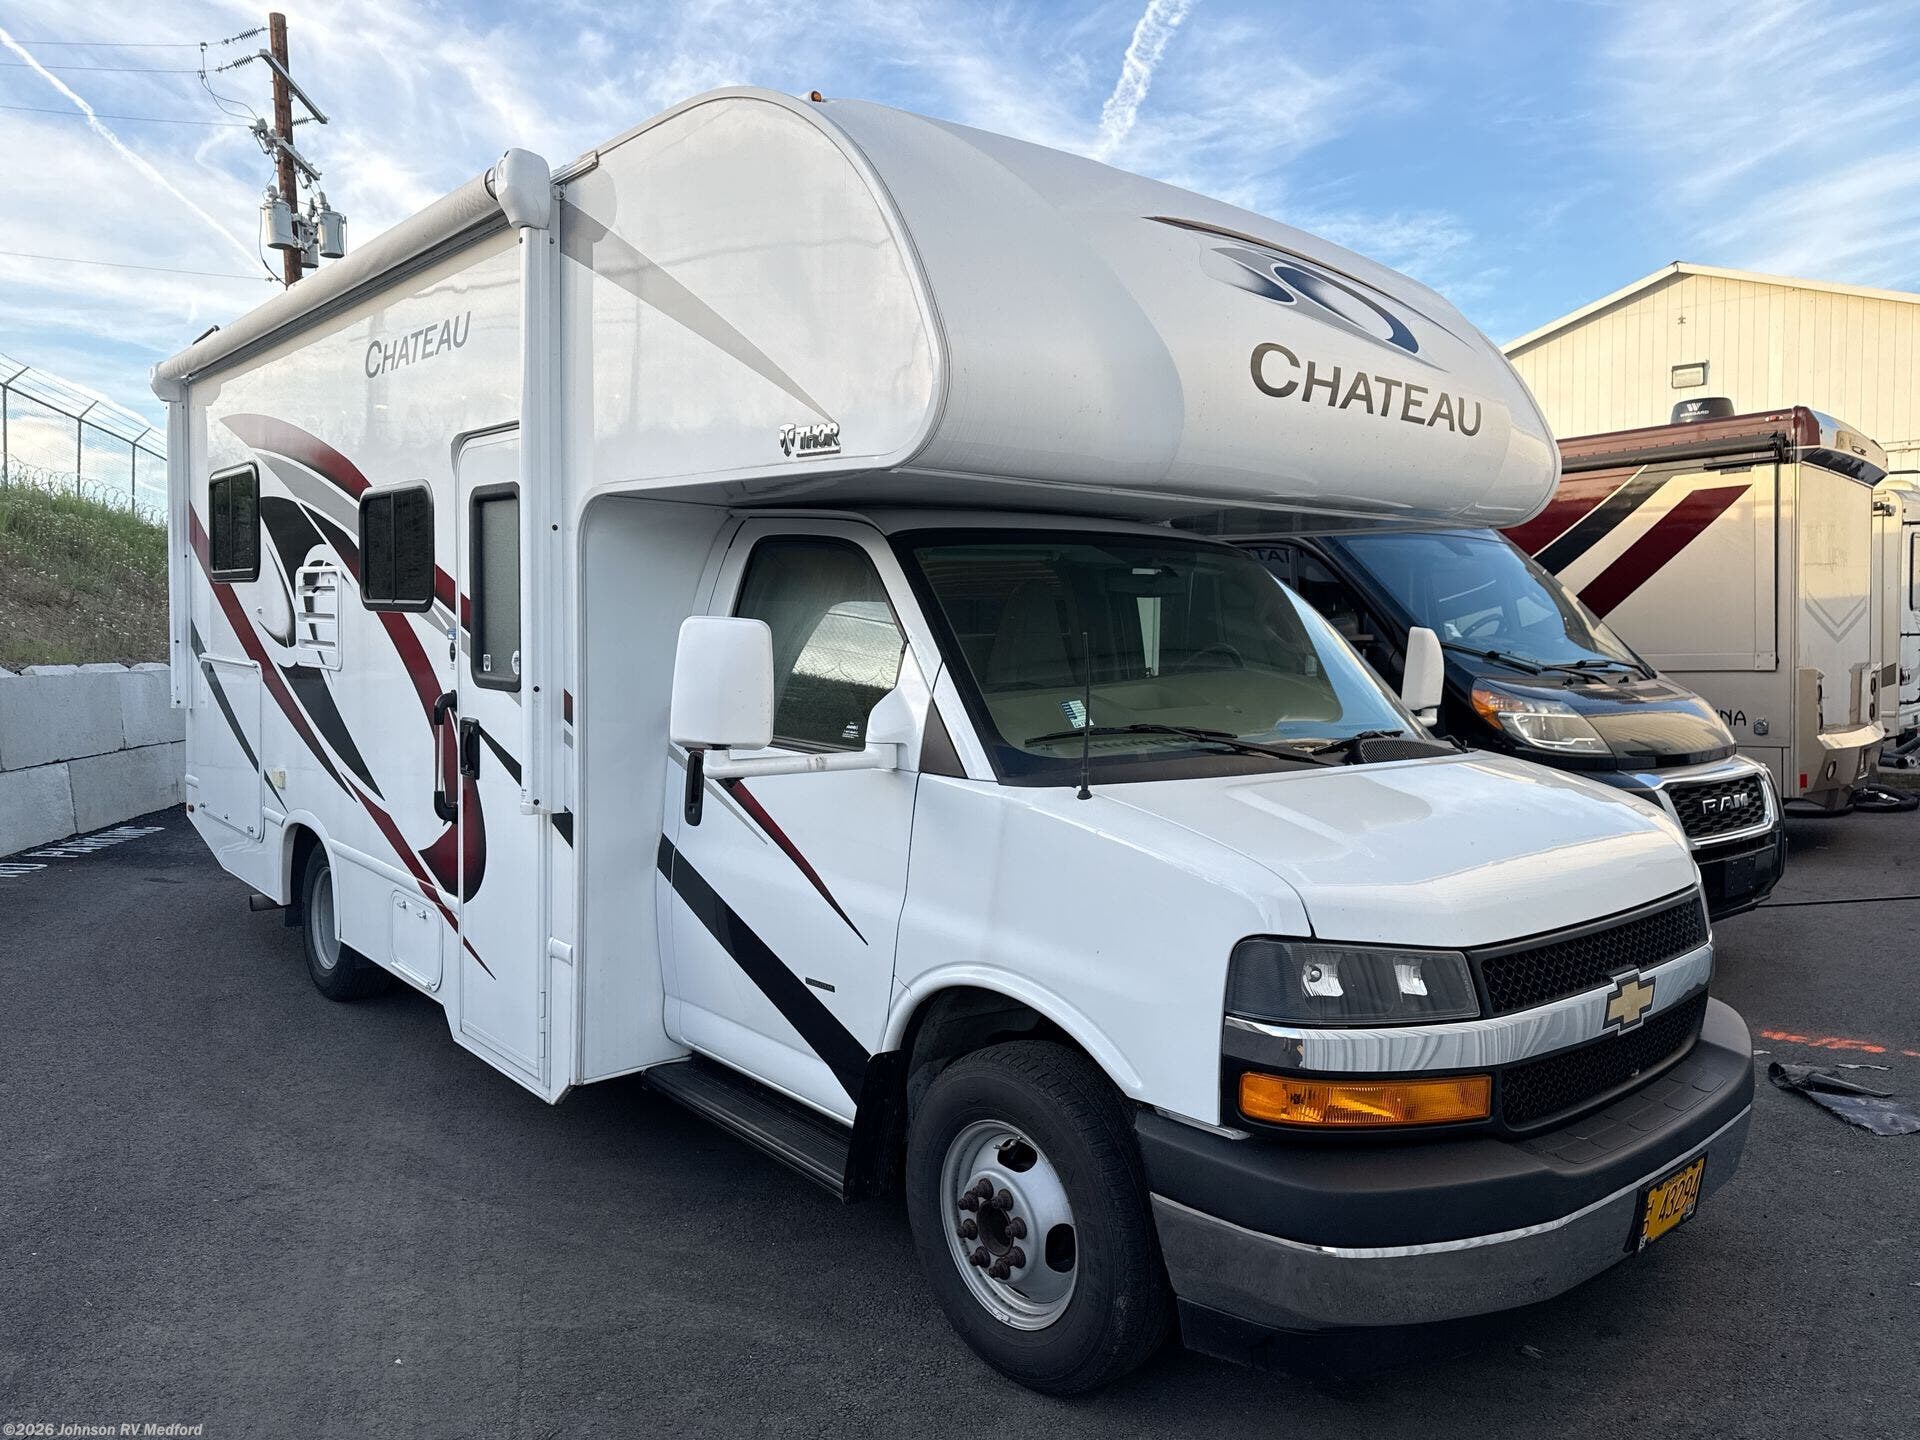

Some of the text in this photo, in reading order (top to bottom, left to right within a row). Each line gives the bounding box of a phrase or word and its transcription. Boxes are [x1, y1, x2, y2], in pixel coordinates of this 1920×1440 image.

[365, 310, 471, 379] CHATEAU
[1250, 342, 1482, 437] CHATEAU
[1702, 792, 1749, 815] RAM
[1658, 1169, 1701, 1222] 43294
